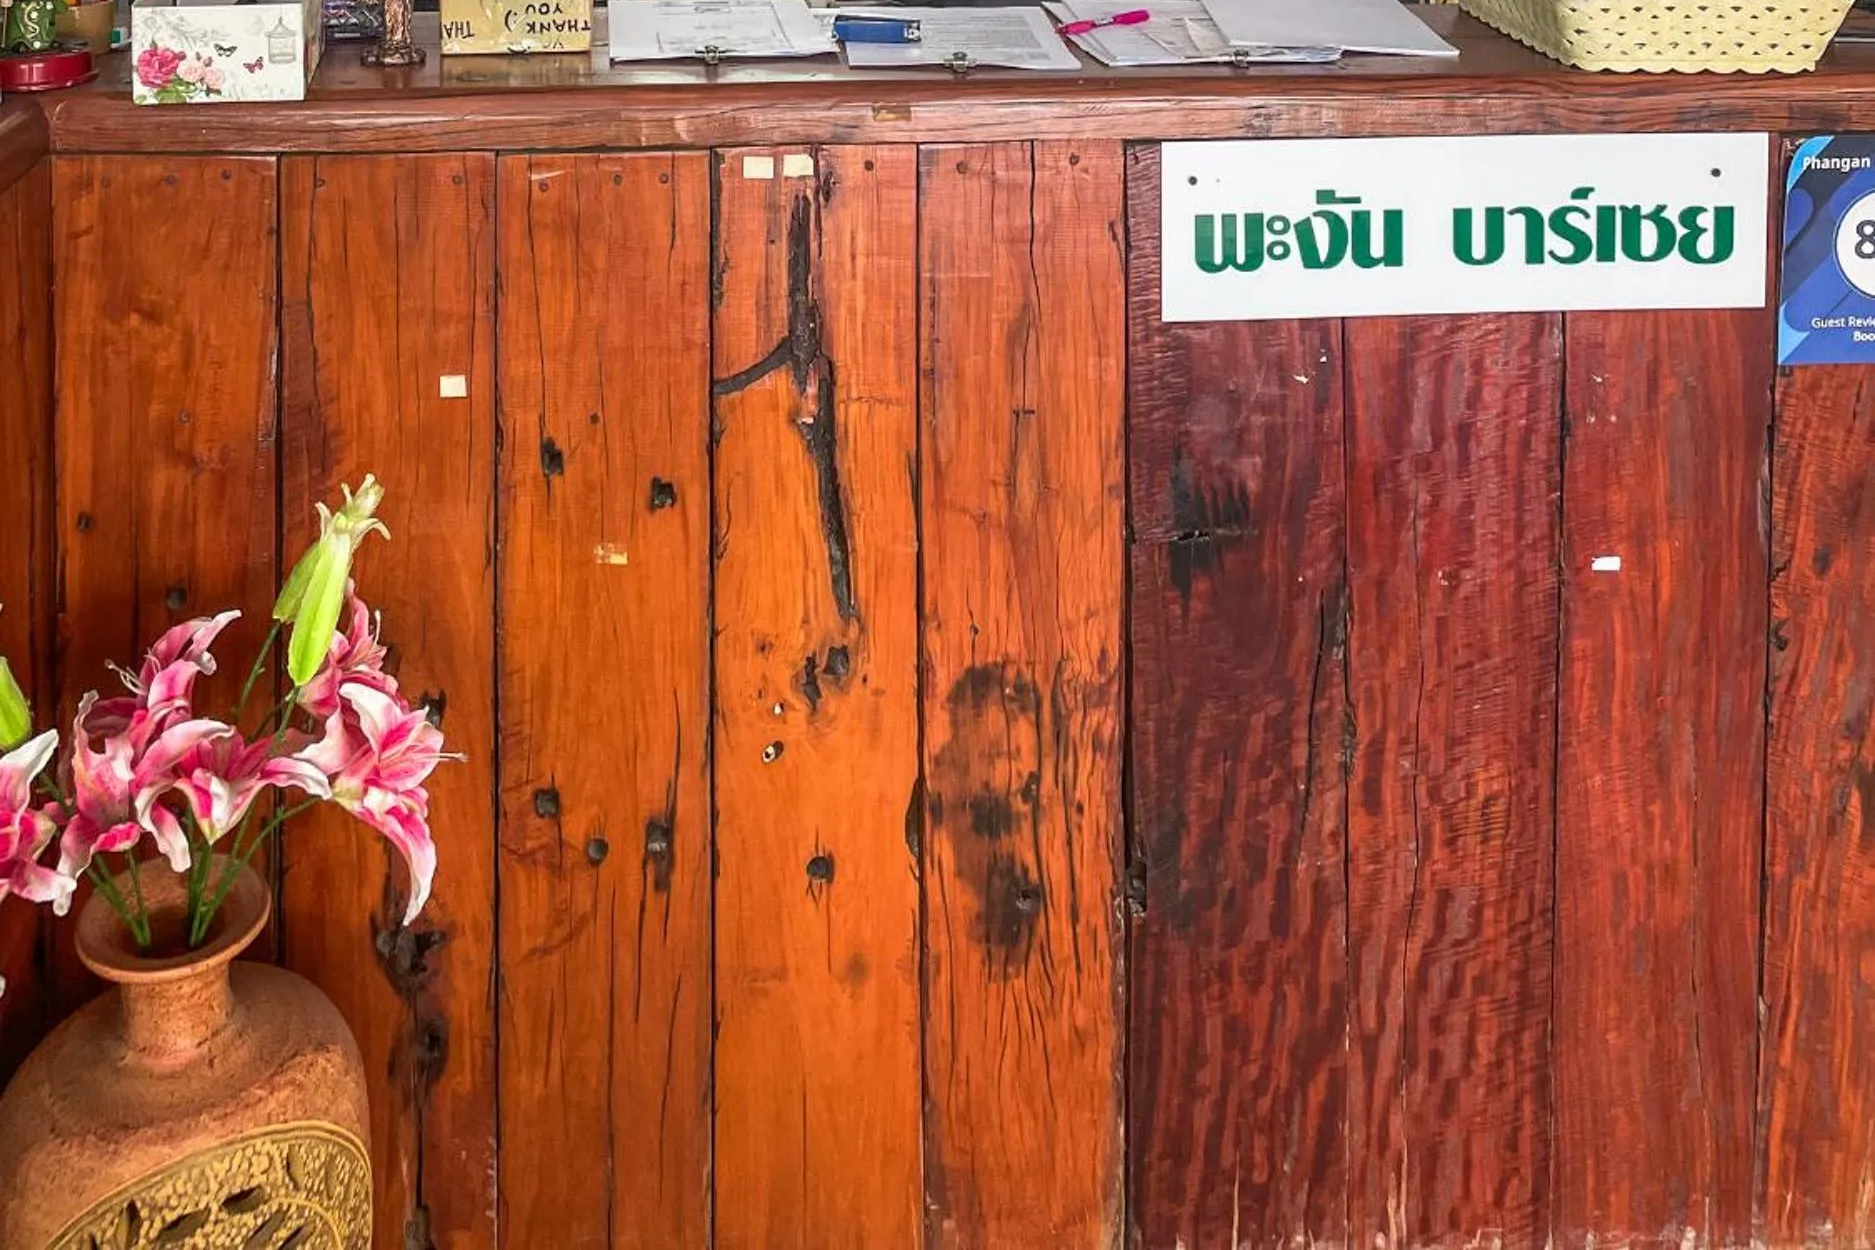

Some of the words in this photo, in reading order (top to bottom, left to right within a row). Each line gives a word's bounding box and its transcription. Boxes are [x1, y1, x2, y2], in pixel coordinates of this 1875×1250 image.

[525, 2, 564, 16] YOU
[441, 20, 476, 39] THA
[526, 18, 592, 35] THANK
[1802, 155, 1871, 173] Phangan
[1194, 189, 1404, 274] พะงัน
[1811, 317, 1846, 329] Guest
